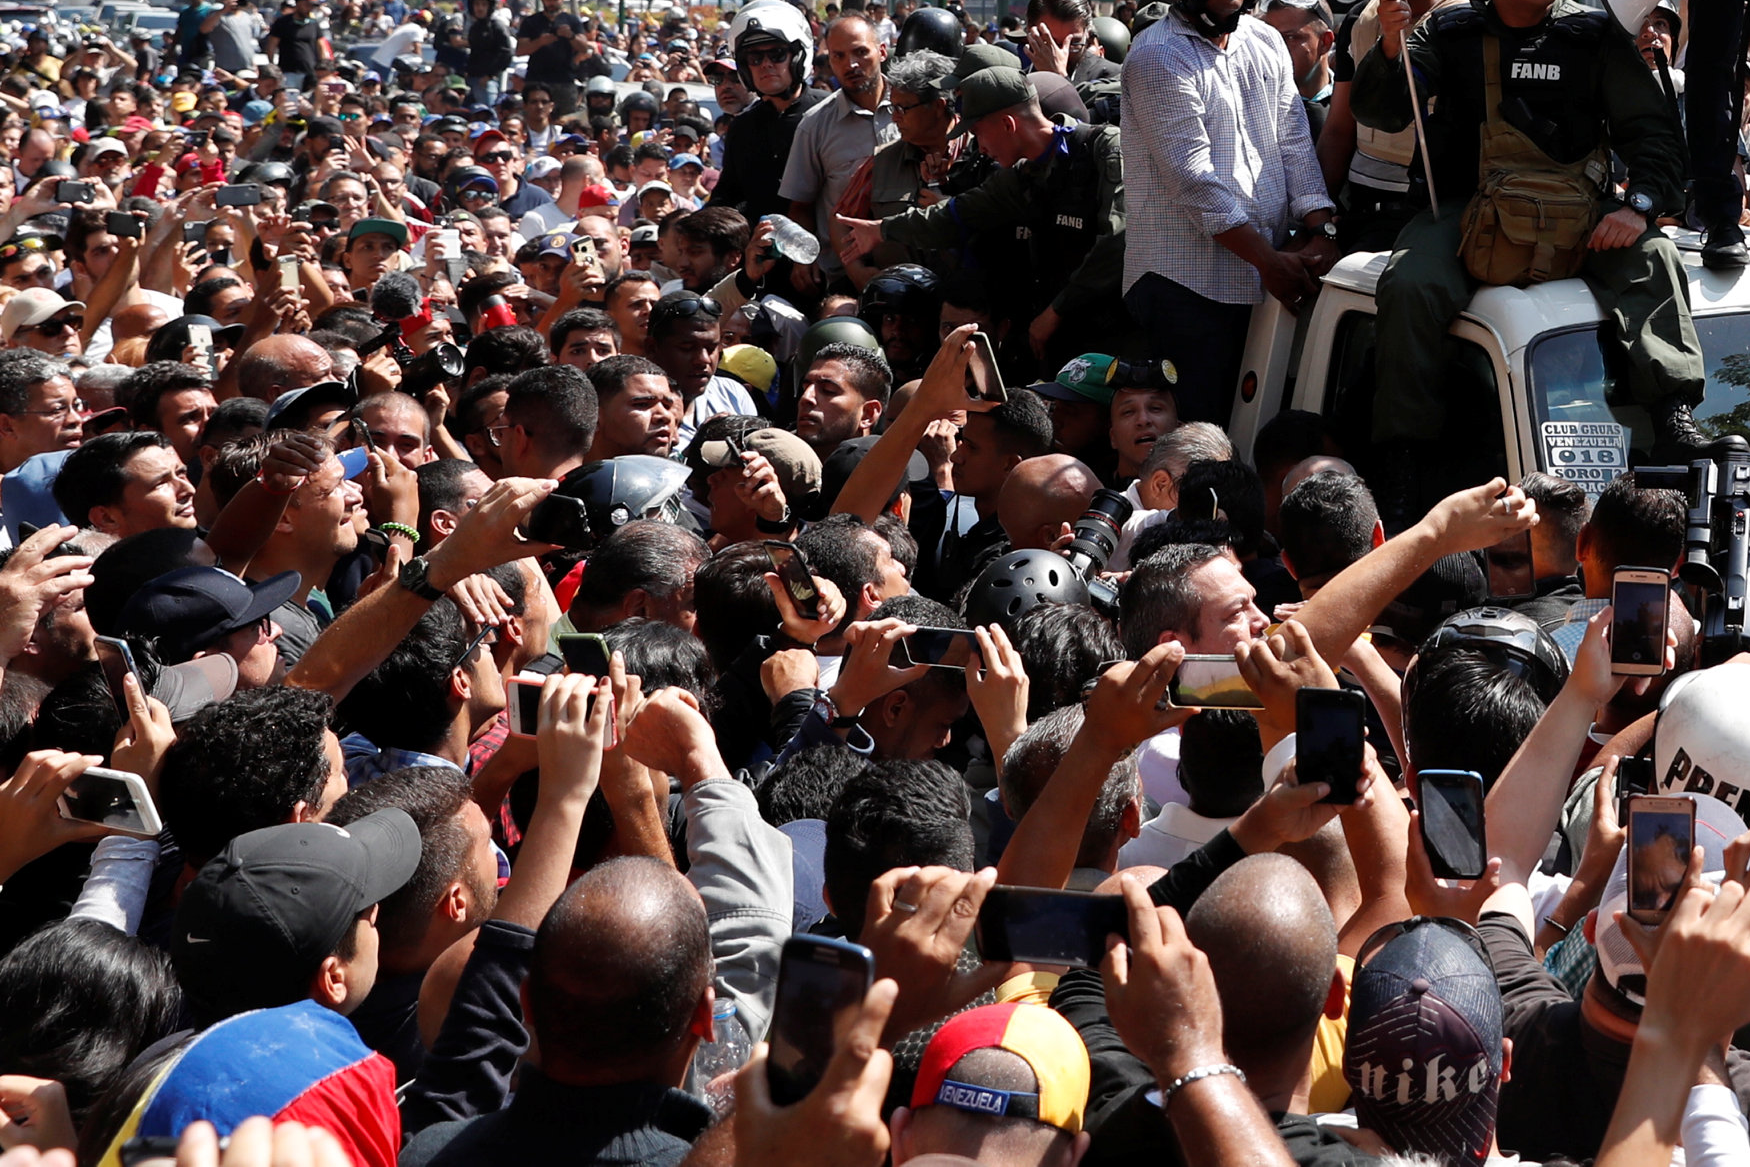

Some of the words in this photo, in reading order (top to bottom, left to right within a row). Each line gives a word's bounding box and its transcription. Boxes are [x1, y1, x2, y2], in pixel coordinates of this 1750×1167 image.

[1511, 62, 1561, 80] FANB
[1056, 214, 1083, 229] FANB
[1544, 424, 1578, 435] CLUB
[1580, 424, 1621, 435] GRUAS
[1546, 436, 1623, 448] VENEZUELA
[1558, 449, 1615, 464] 018
[1359, 1053, 1488, 1106] nike
[938, 1084, 1003, 1113] VENEZUELA
